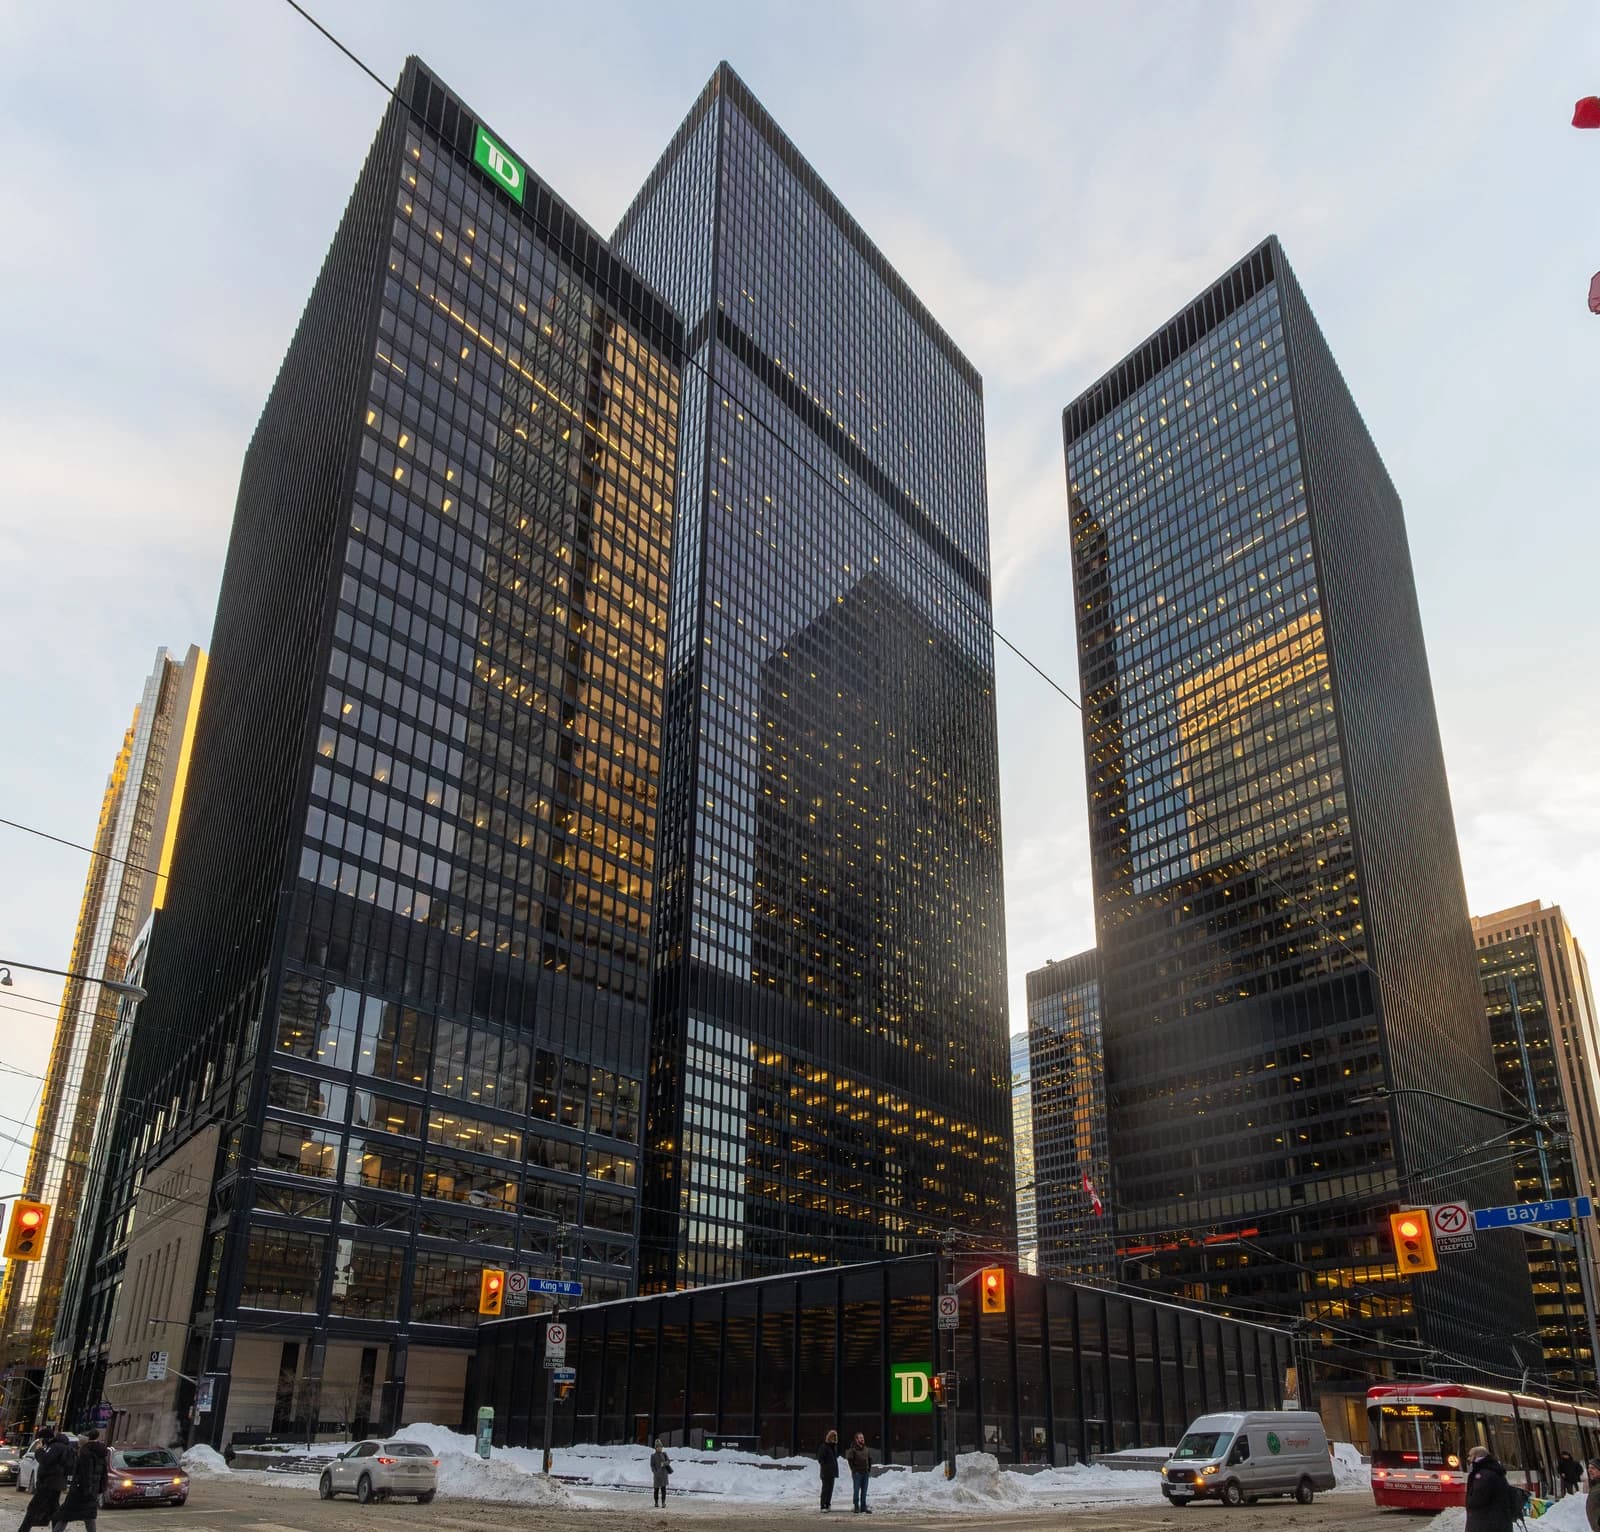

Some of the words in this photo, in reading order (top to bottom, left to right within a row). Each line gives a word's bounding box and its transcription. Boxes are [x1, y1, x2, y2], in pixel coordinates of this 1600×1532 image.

[482, 135, 519, 188] TD
[1506, 1206, 1539, 1221] Bay
[1544, 1202, 1554, 1211] St
[1439, 1242, 1473, 1251] EXCEPTED
[540, 1280, 557, 1292] King
[563, 1283, 571, 1292] W
[895, 1371, 929, 1403] TD
